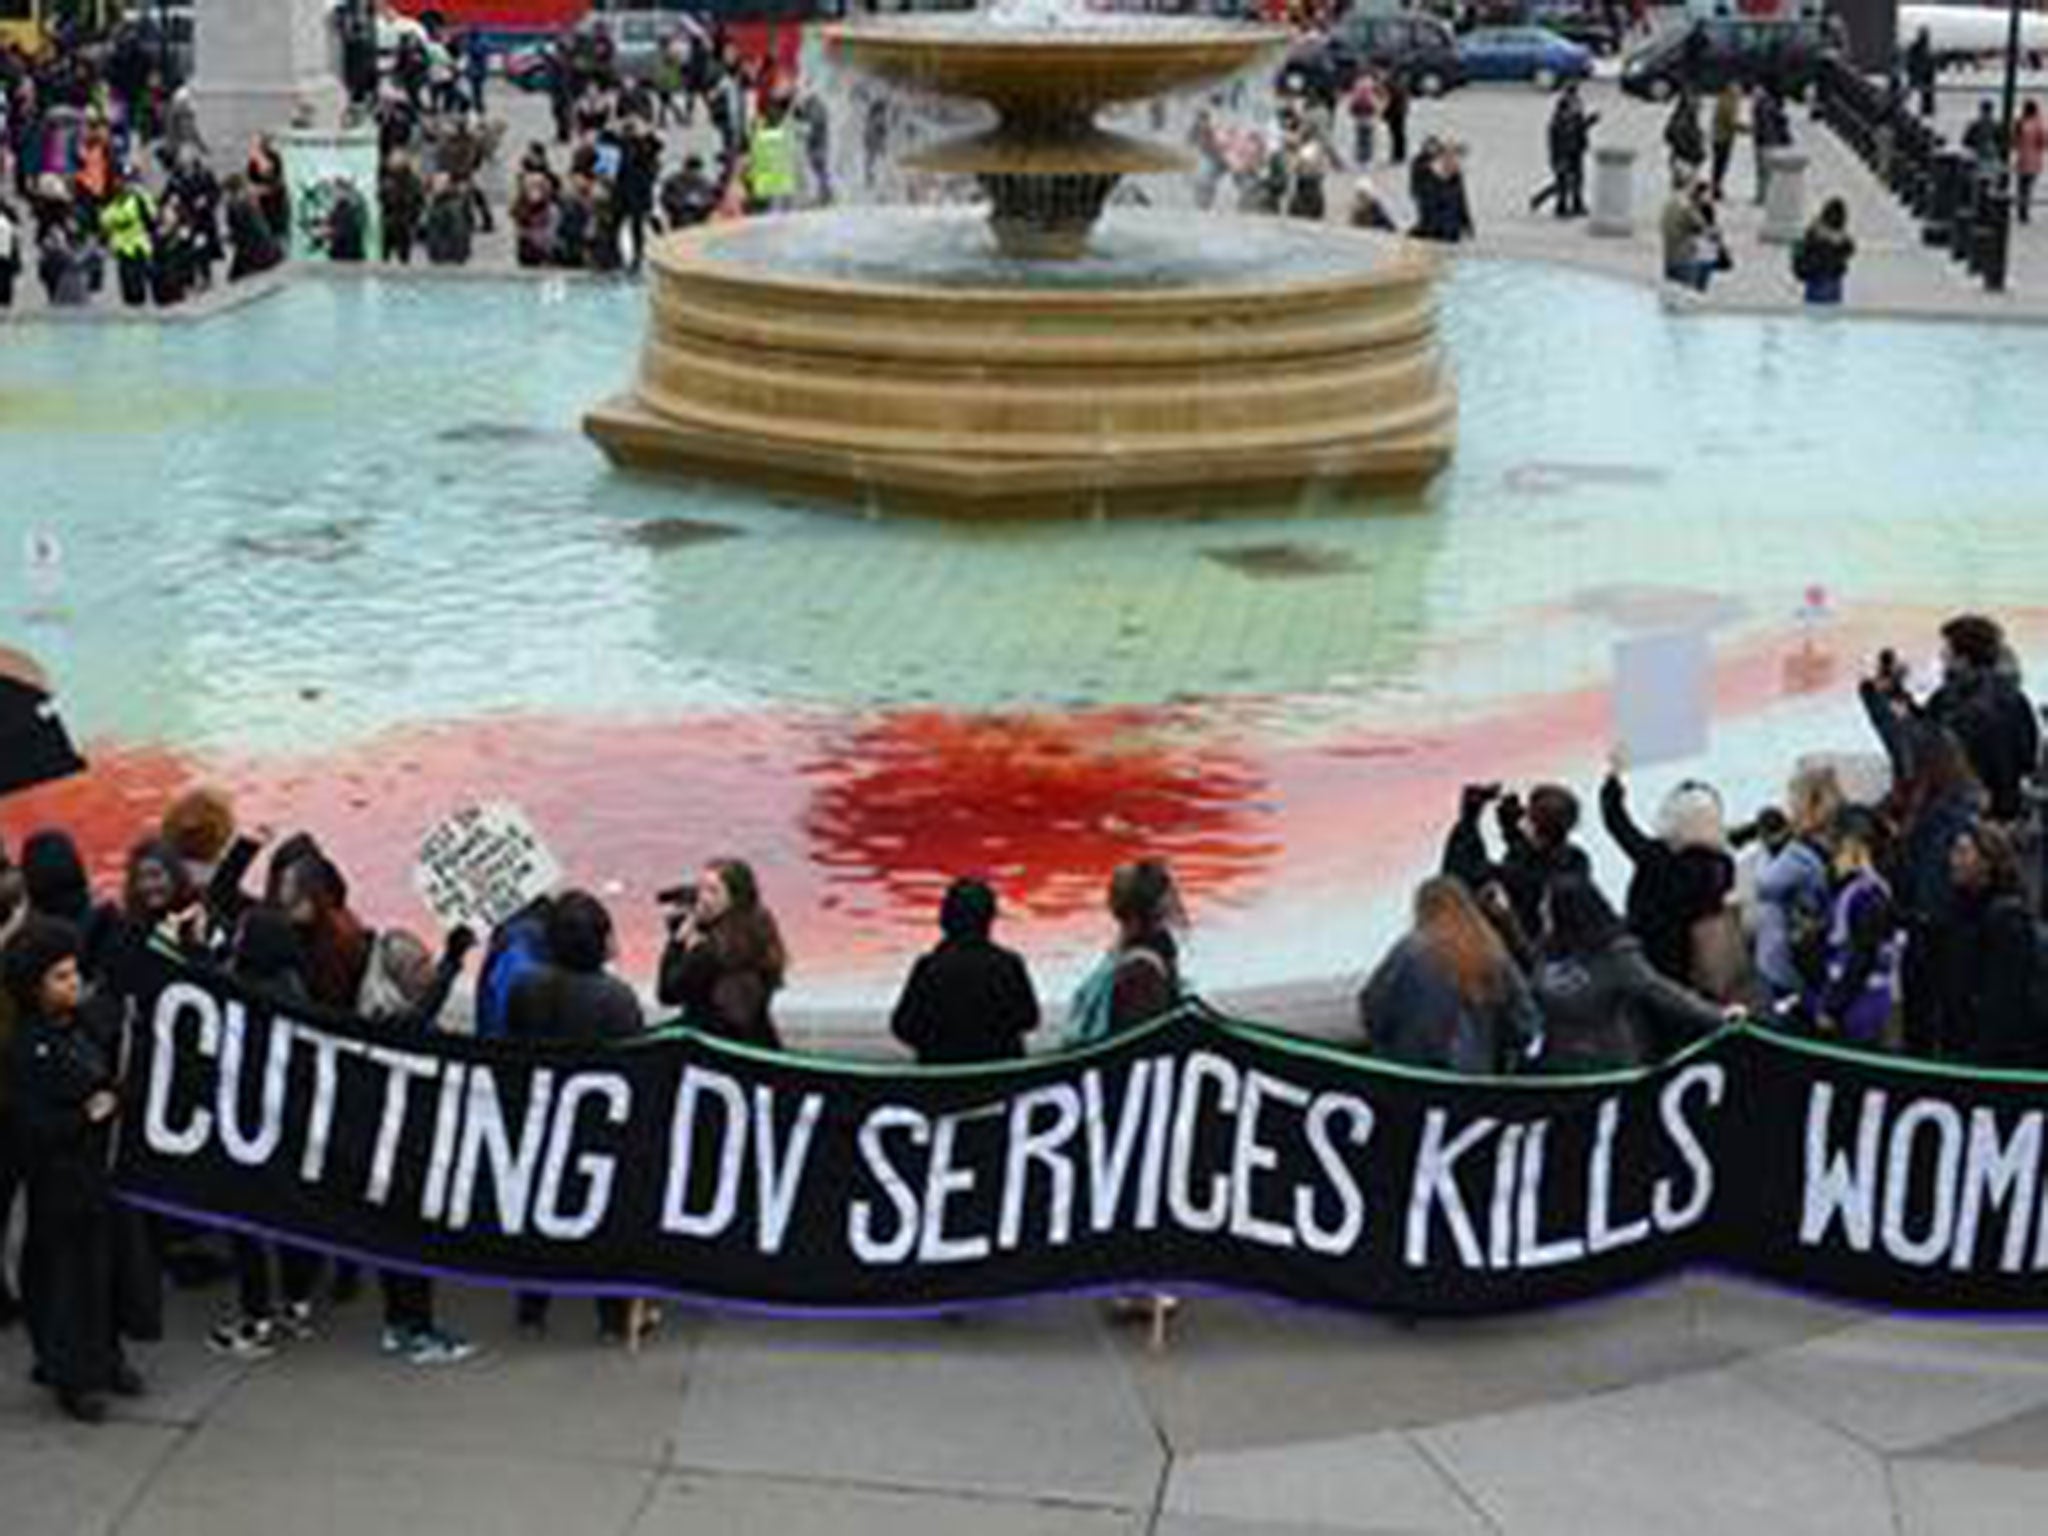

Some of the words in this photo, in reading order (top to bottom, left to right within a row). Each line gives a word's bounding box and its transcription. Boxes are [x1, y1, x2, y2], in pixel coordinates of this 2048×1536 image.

[145, 982, 632, 1239] CUTTING
[662, 1064, 823, 1253] DV
[848, 1052, 1373, 1263] SERVICES
[1405, 1064, 1725, 1267] KILLS
[1801, 1081, 2048, 1272] WOM
